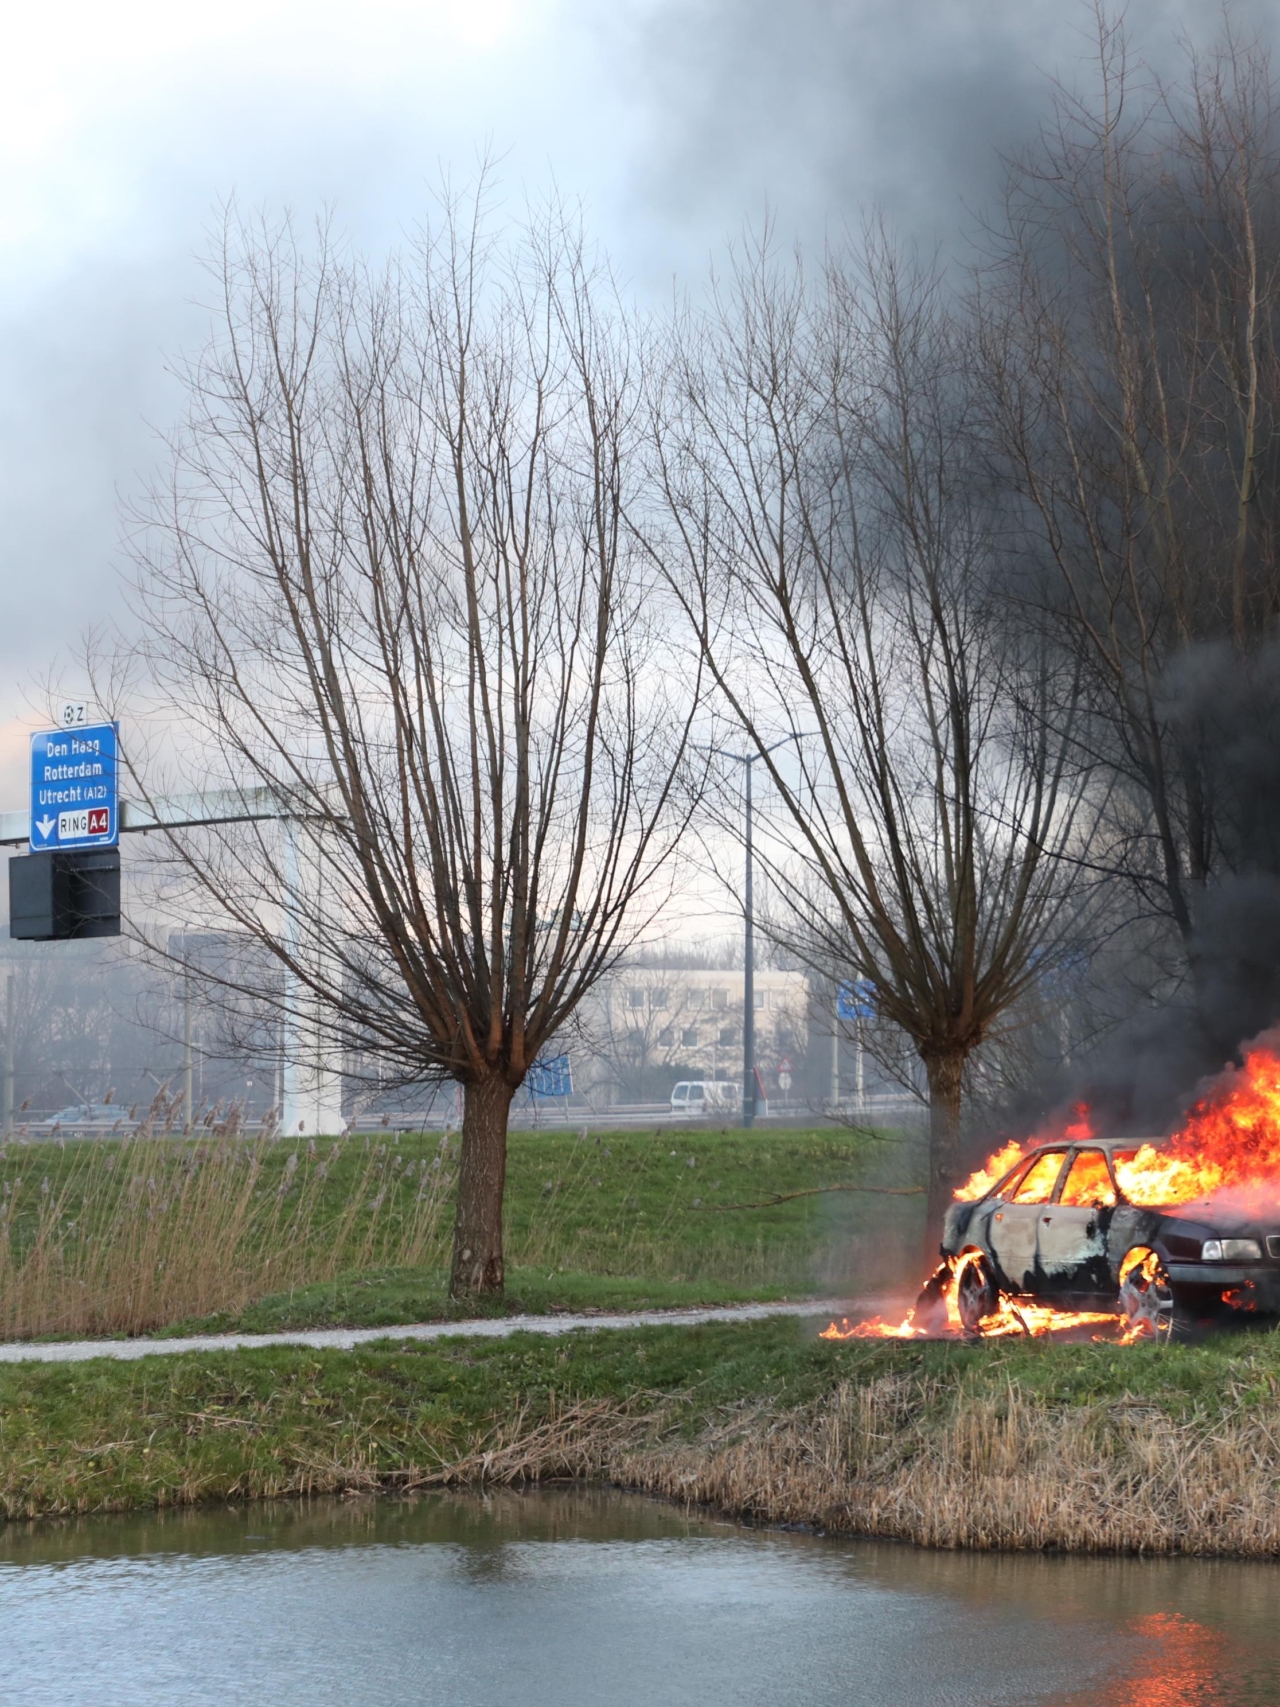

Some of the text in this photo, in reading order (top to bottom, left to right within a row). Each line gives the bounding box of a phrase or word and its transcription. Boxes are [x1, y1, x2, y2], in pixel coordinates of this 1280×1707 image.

[77, 707, 84, 721] Z
[47, 739, 100, 758] Den Haag
[44, 761, 103, 782] Rotterdam
[39, 786, 107, 805] Utrecht (A12)
[60, 813, 107, 833] RING A4
